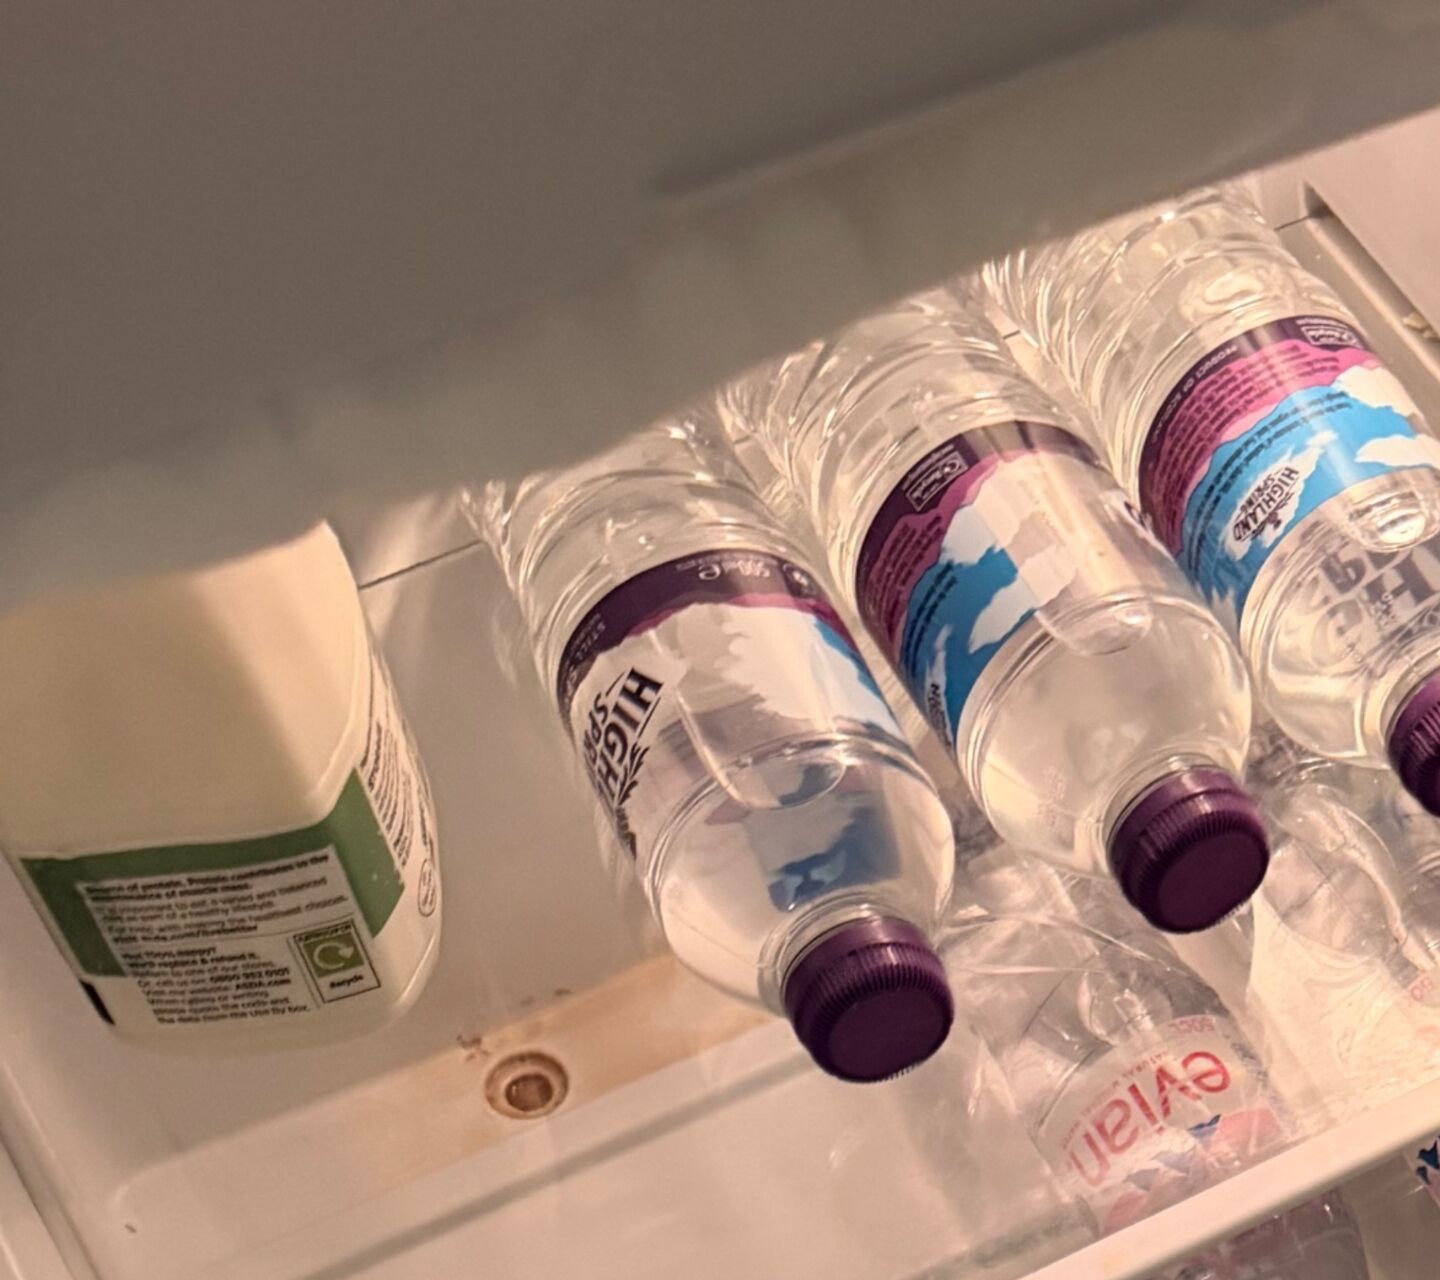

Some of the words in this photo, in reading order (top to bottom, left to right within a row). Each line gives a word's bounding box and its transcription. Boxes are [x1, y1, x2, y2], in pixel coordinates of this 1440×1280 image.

[1233, 466, 1299, 542] HIGHLAND
[1239, 473, 1276, 515] SPRING
[1069, 1051, 1231, 1183] evian
